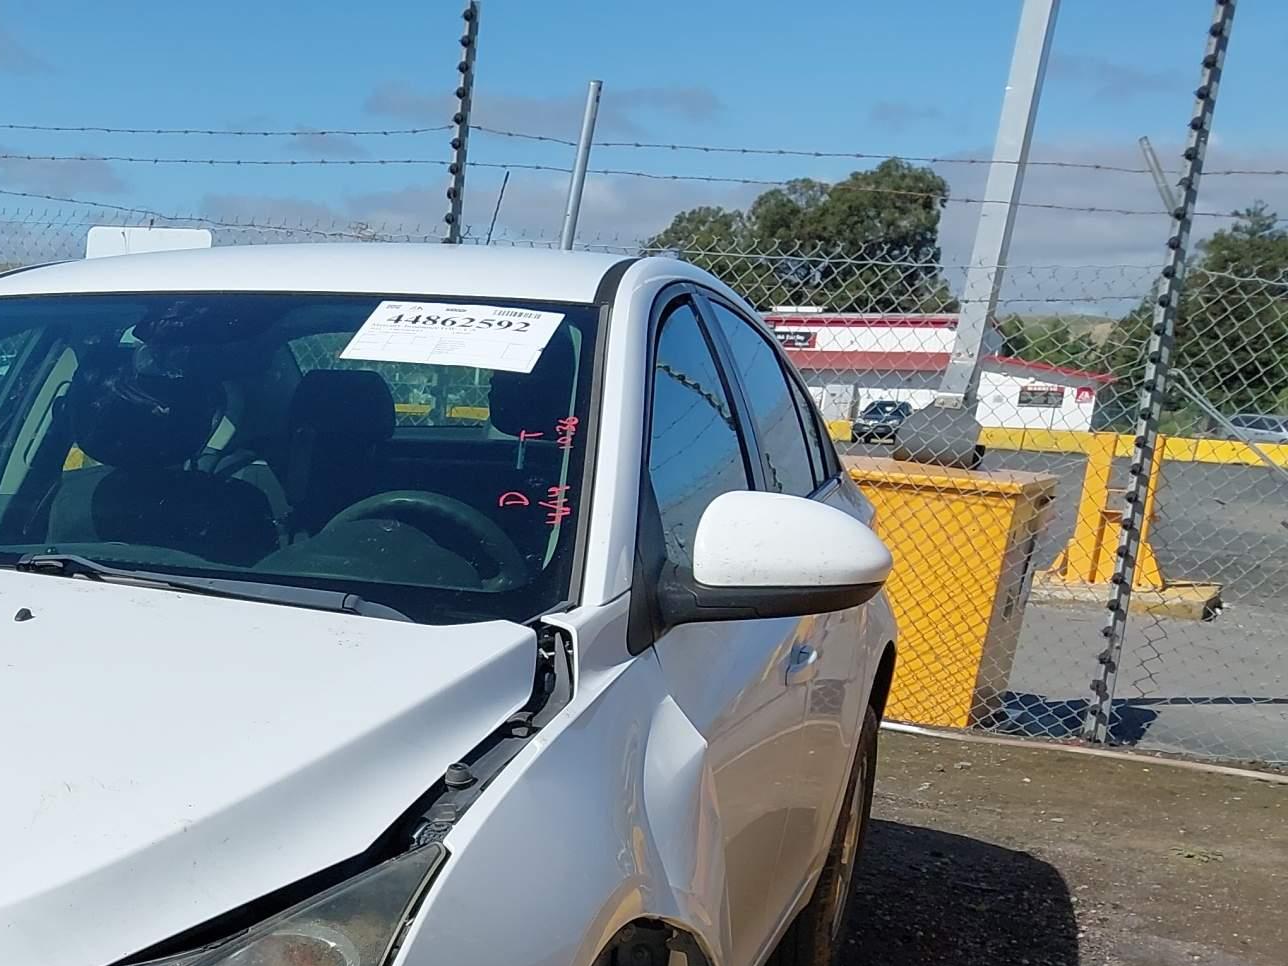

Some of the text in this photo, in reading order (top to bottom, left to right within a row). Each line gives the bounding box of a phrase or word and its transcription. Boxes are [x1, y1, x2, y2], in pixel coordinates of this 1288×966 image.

[387, 313, 531, 333] 44862592
[520, 430, 544, 442] T
[499, 492, 530, 507] D
[538, 485, 571, 525] 4/14
